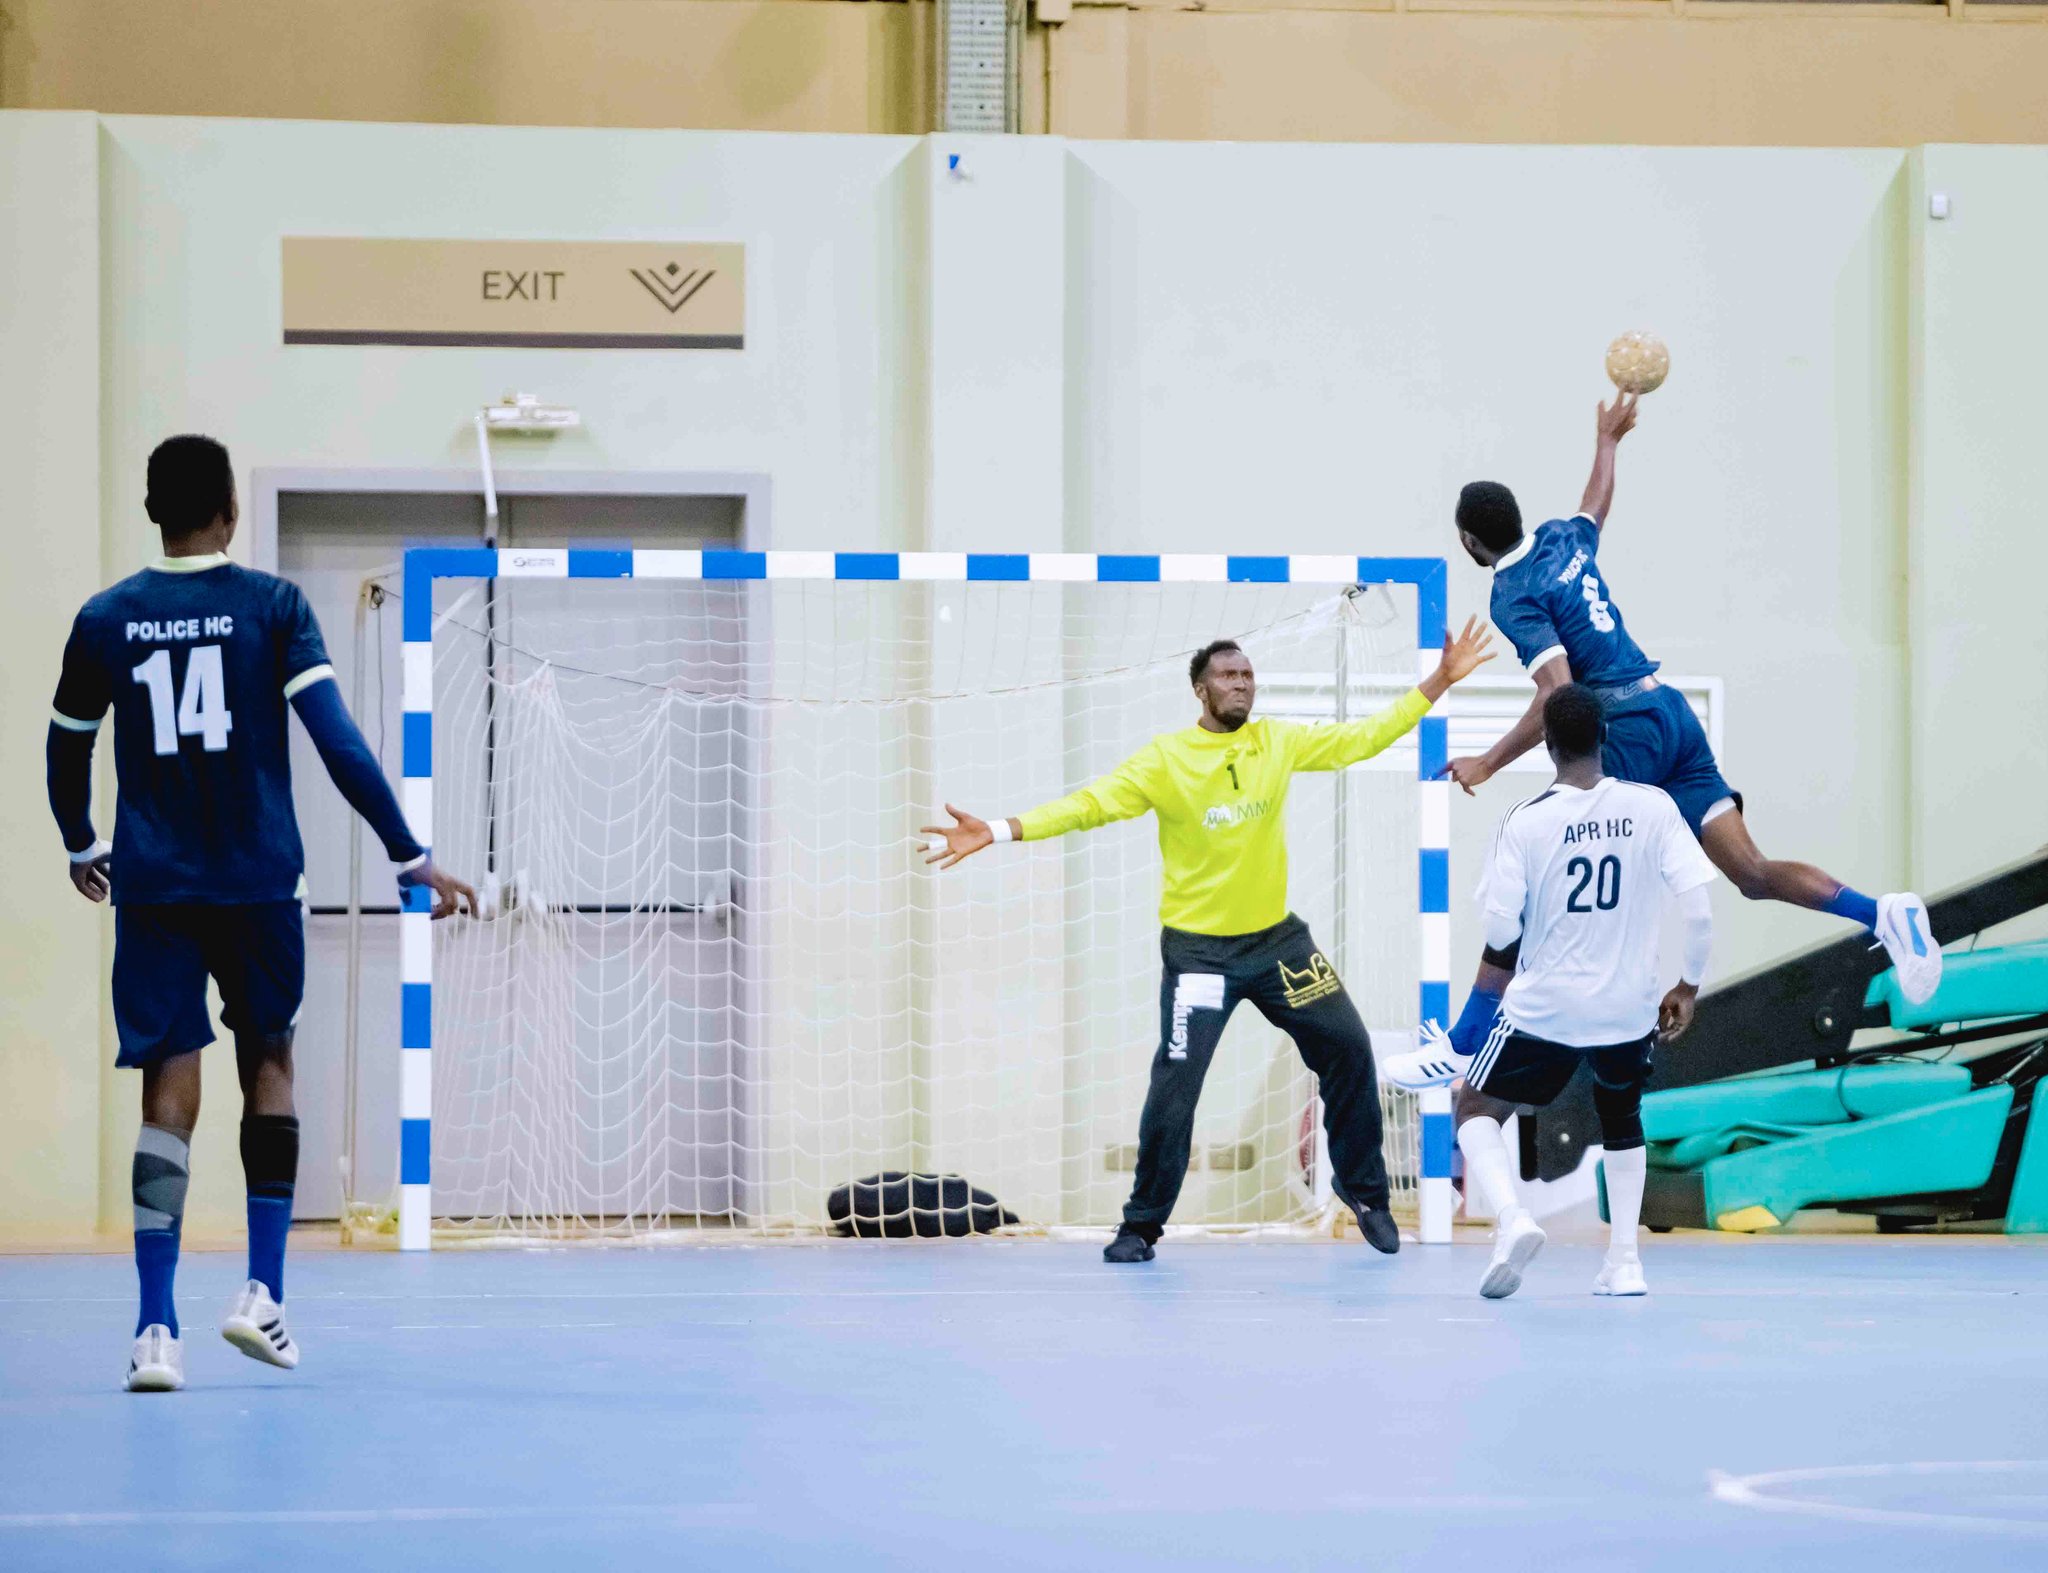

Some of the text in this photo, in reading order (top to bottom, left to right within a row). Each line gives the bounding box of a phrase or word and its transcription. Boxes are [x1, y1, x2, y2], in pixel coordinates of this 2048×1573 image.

[483, 270, 565, 301] EXIT
[126, 615, 234, 642] POLICE HC
[131, 644, 233, 756] 14
[1226, 763, 1239, 790] 1
[1563, 818, 1633, 844] APR HC
[1566, 854, 1622, 913] 20
